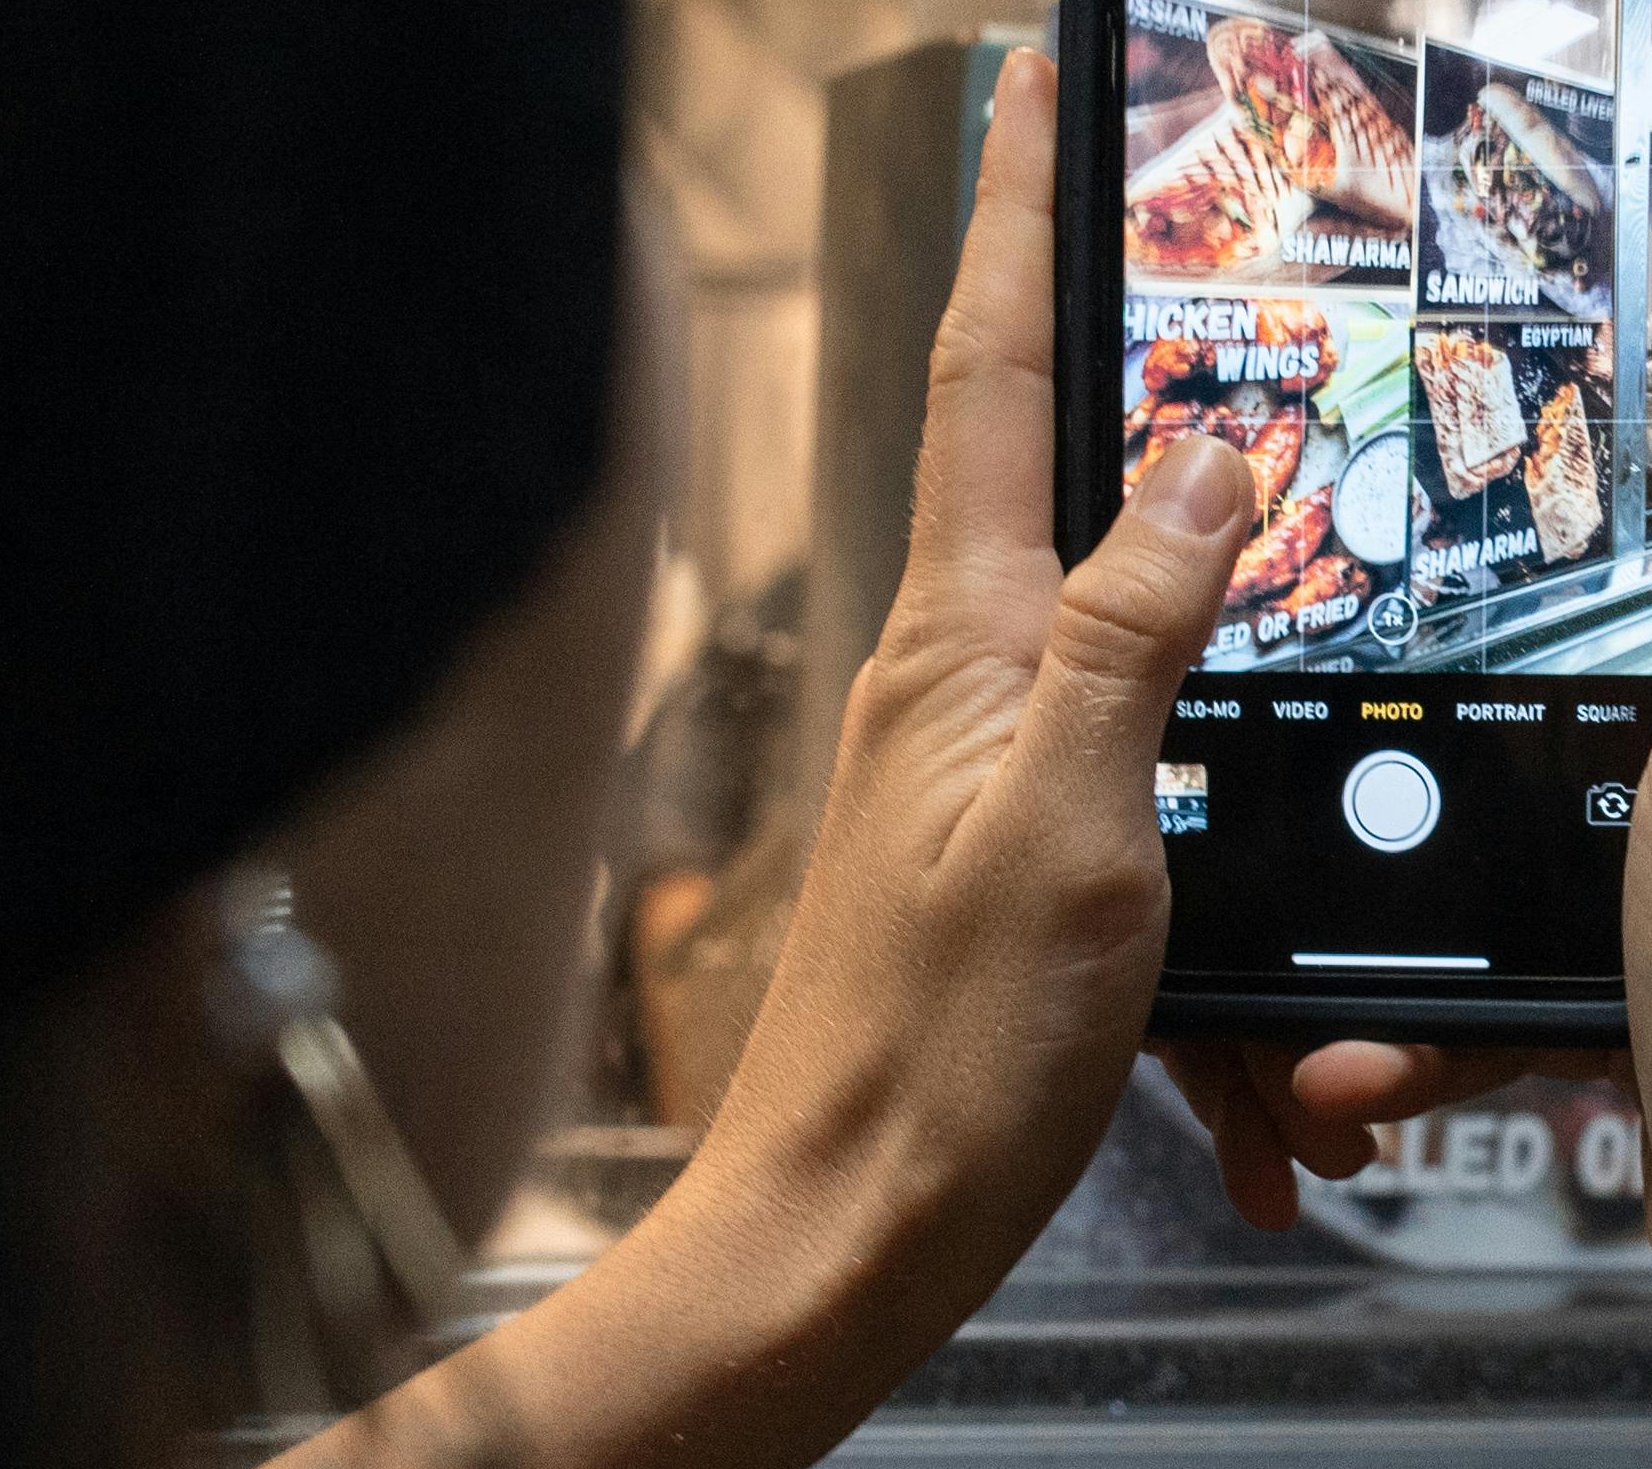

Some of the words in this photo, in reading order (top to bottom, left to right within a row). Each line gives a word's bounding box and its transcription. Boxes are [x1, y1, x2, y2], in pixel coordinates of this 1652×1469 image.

[1525, 78, 1578, 113] GRILLED
[1280, 232, 1412, 270] SHAWARMA
[1425, 269, 1540, 306] SANDWICH
[1521, 323, 1594, 348] EGYPTIAN
[1215, 342, 1321, 383] WINGS
[1415, 526, 1538, 582] SHAWARMA
[1257, 610, 1291, 644] OR
[1296, 593, 1360, 633] FRIED
[1175, 699, 1241, 719] SLO-MO
[1273, 700, 1329, 721] VIDEO
[1361, 701, 1424, 721] PHOTO
[1456, 702, 1546, 723] PORTRAIT
[1576, 703, 1638, 724] SQUARE
[1574, 1112, 1644, 1196] O
